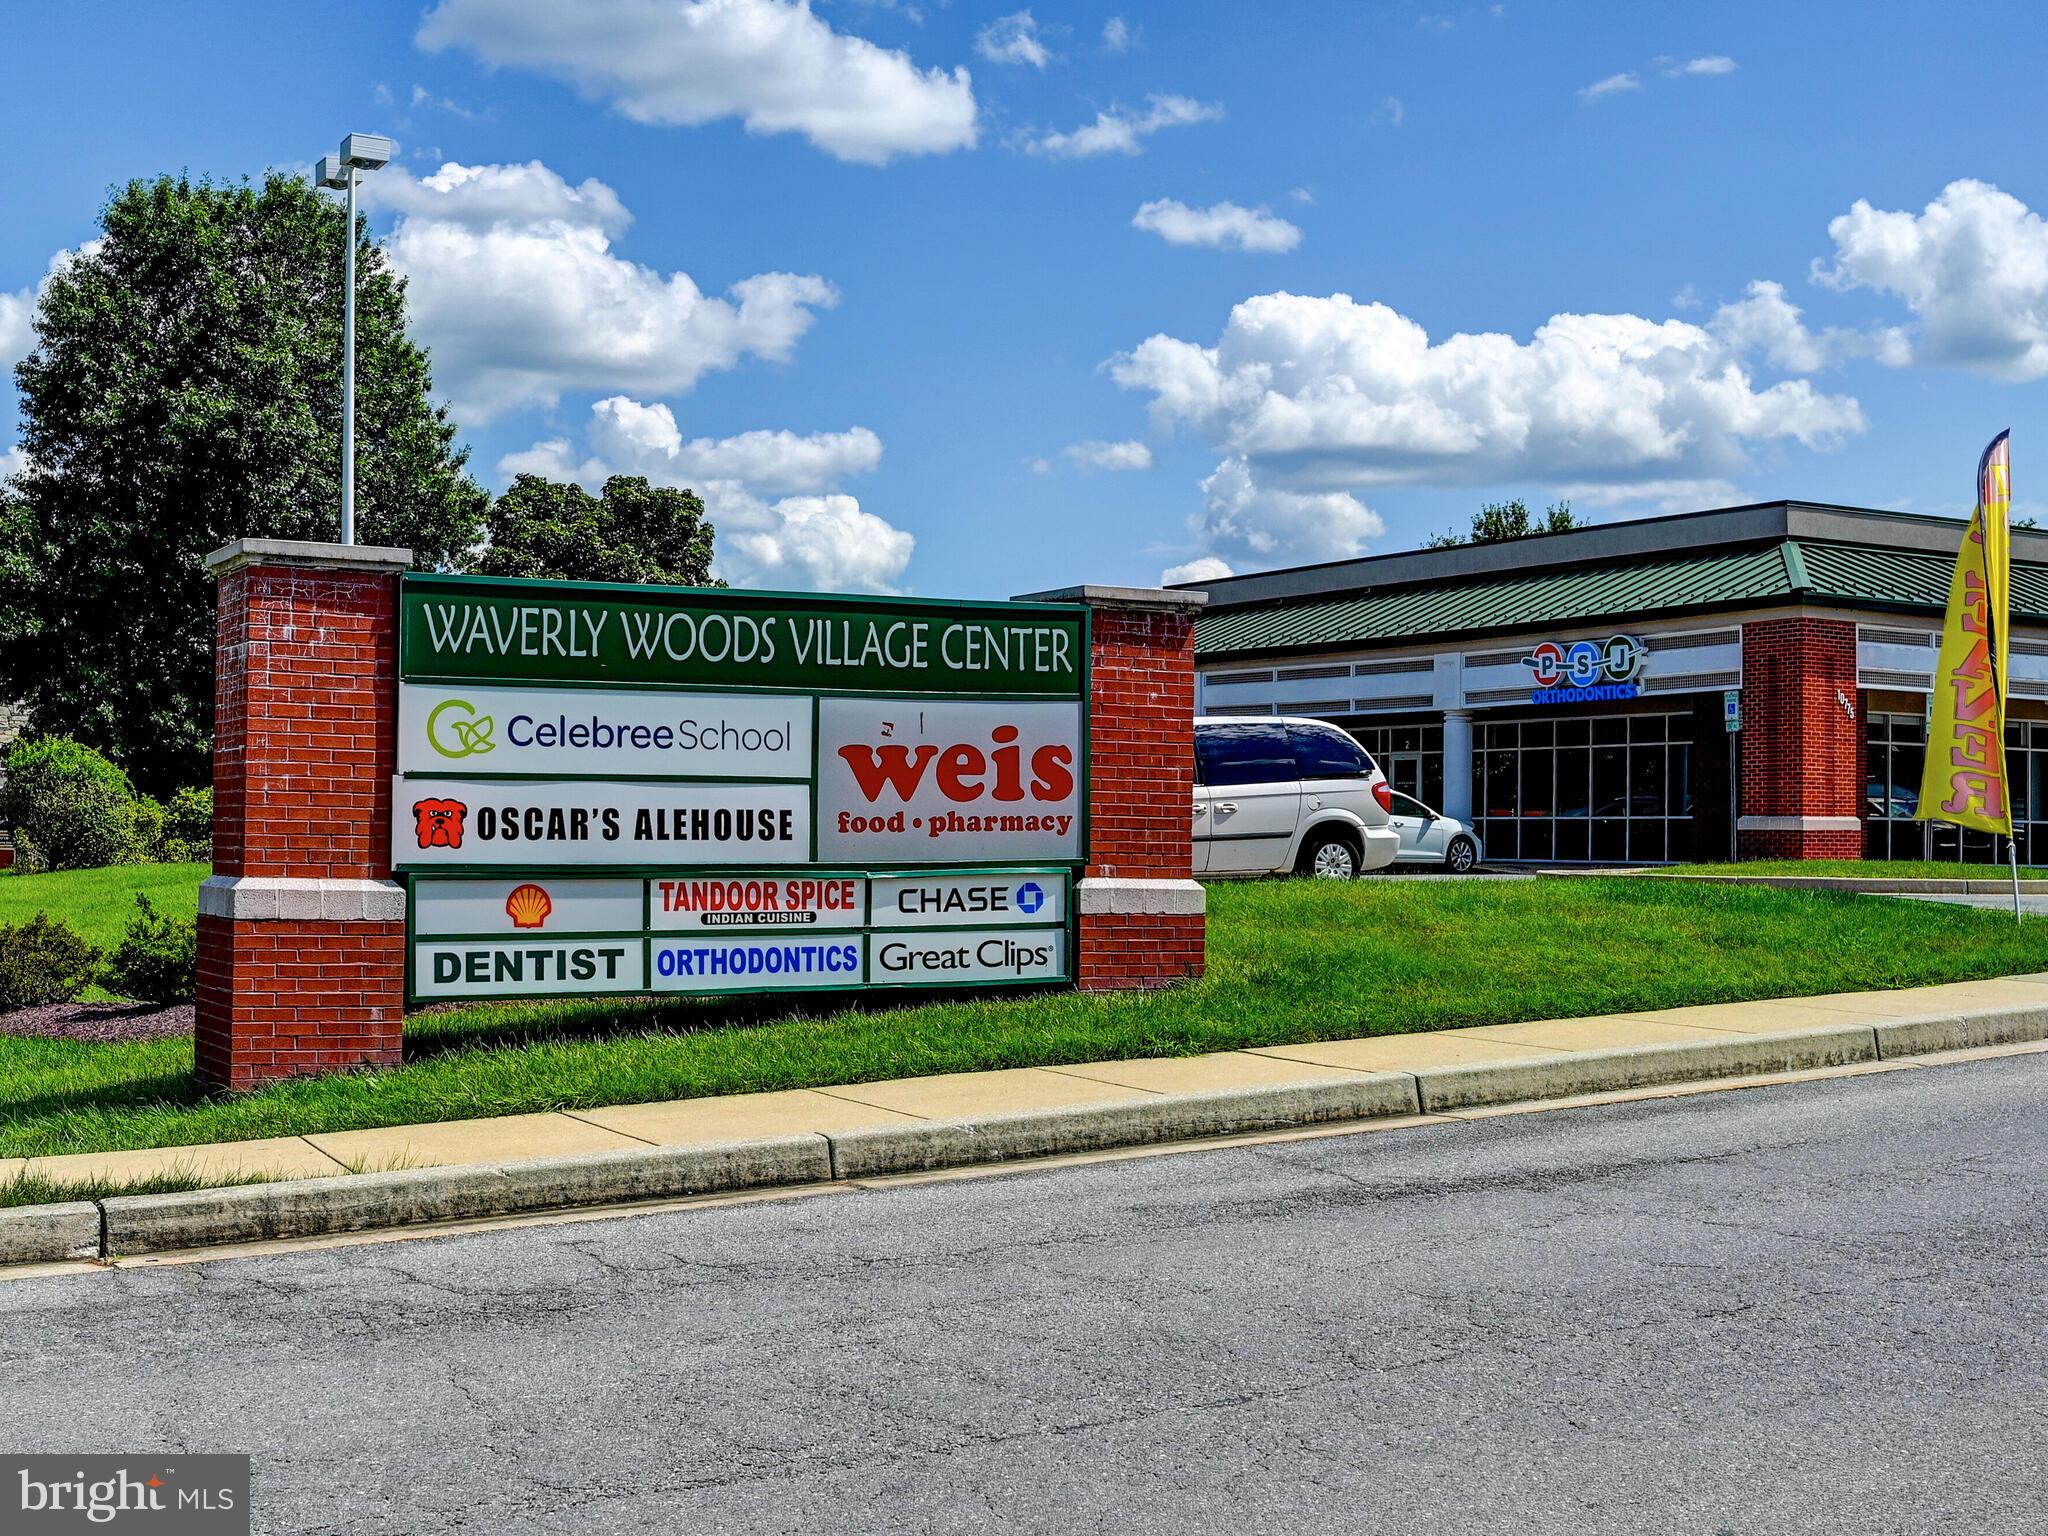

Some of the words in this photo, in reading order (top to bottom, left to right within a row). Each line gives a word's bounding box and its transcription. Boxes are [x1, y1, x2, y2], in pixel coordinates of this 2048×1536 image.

[422, 603, 608, 658] WAVERLY
[620, 611, 776, 664] WOODS
[788, 617, 928, 669] VILLAGE
[941, 624, 1073, 673] CENTER
[1532, 684, 1637, 704] ORTHODONTICS
[1837, 689, 1855, 719] 10775
[837, 725, 1074, 802] weis
[477, 807, 620, 841] OSCAR'S
[634, 808, 793, 841] ALEHOUSE
[838, 811, 905, 833] food
[928, 811, 1073, 837] pharmacy
[659, 881, 778, 911] TANDOOR
[785, 880, 855, 910] SPICE
[898, 886, 1009, 913] CHASE
[707, 913, 753, 924] INDIAN
[757, 912, 811, 923] CUISINE
[433, 948, 625, 983] DENTIST
[657, 945, 858, 976] ORTHODONTICS
[879, 943, 970, 971] Great
